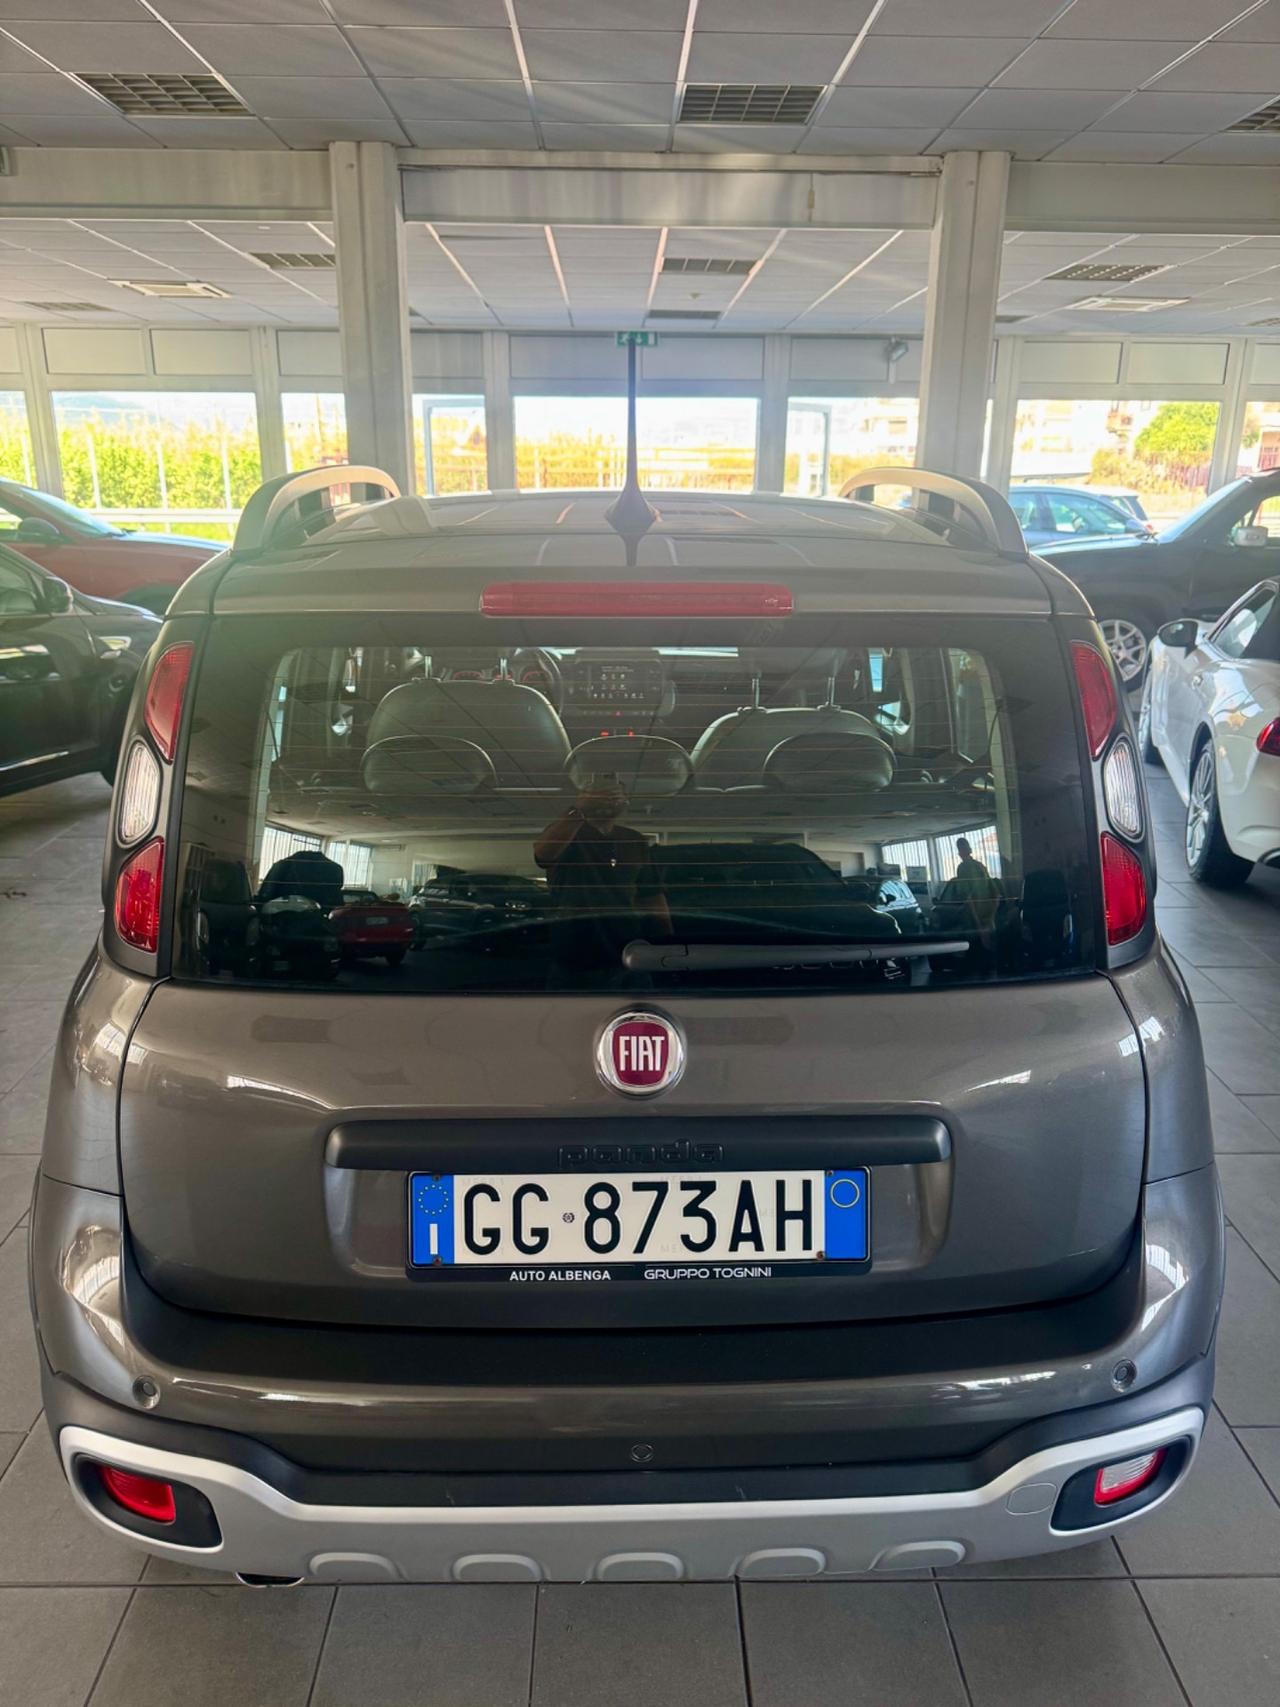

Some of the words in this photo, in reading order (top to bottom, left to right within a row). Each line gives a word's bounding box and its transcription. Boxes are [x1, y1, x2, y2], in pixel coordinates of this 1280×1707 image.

[619, 1035, 665, 1072] FIAT
[509, 1270, 546, 1281] AUTO
[548, 1269, 612, 1281] ALBENGA
[644, 1268, 710, 1280] GRUPPO
[712, 1266, 773, 1279] TOGNINI
